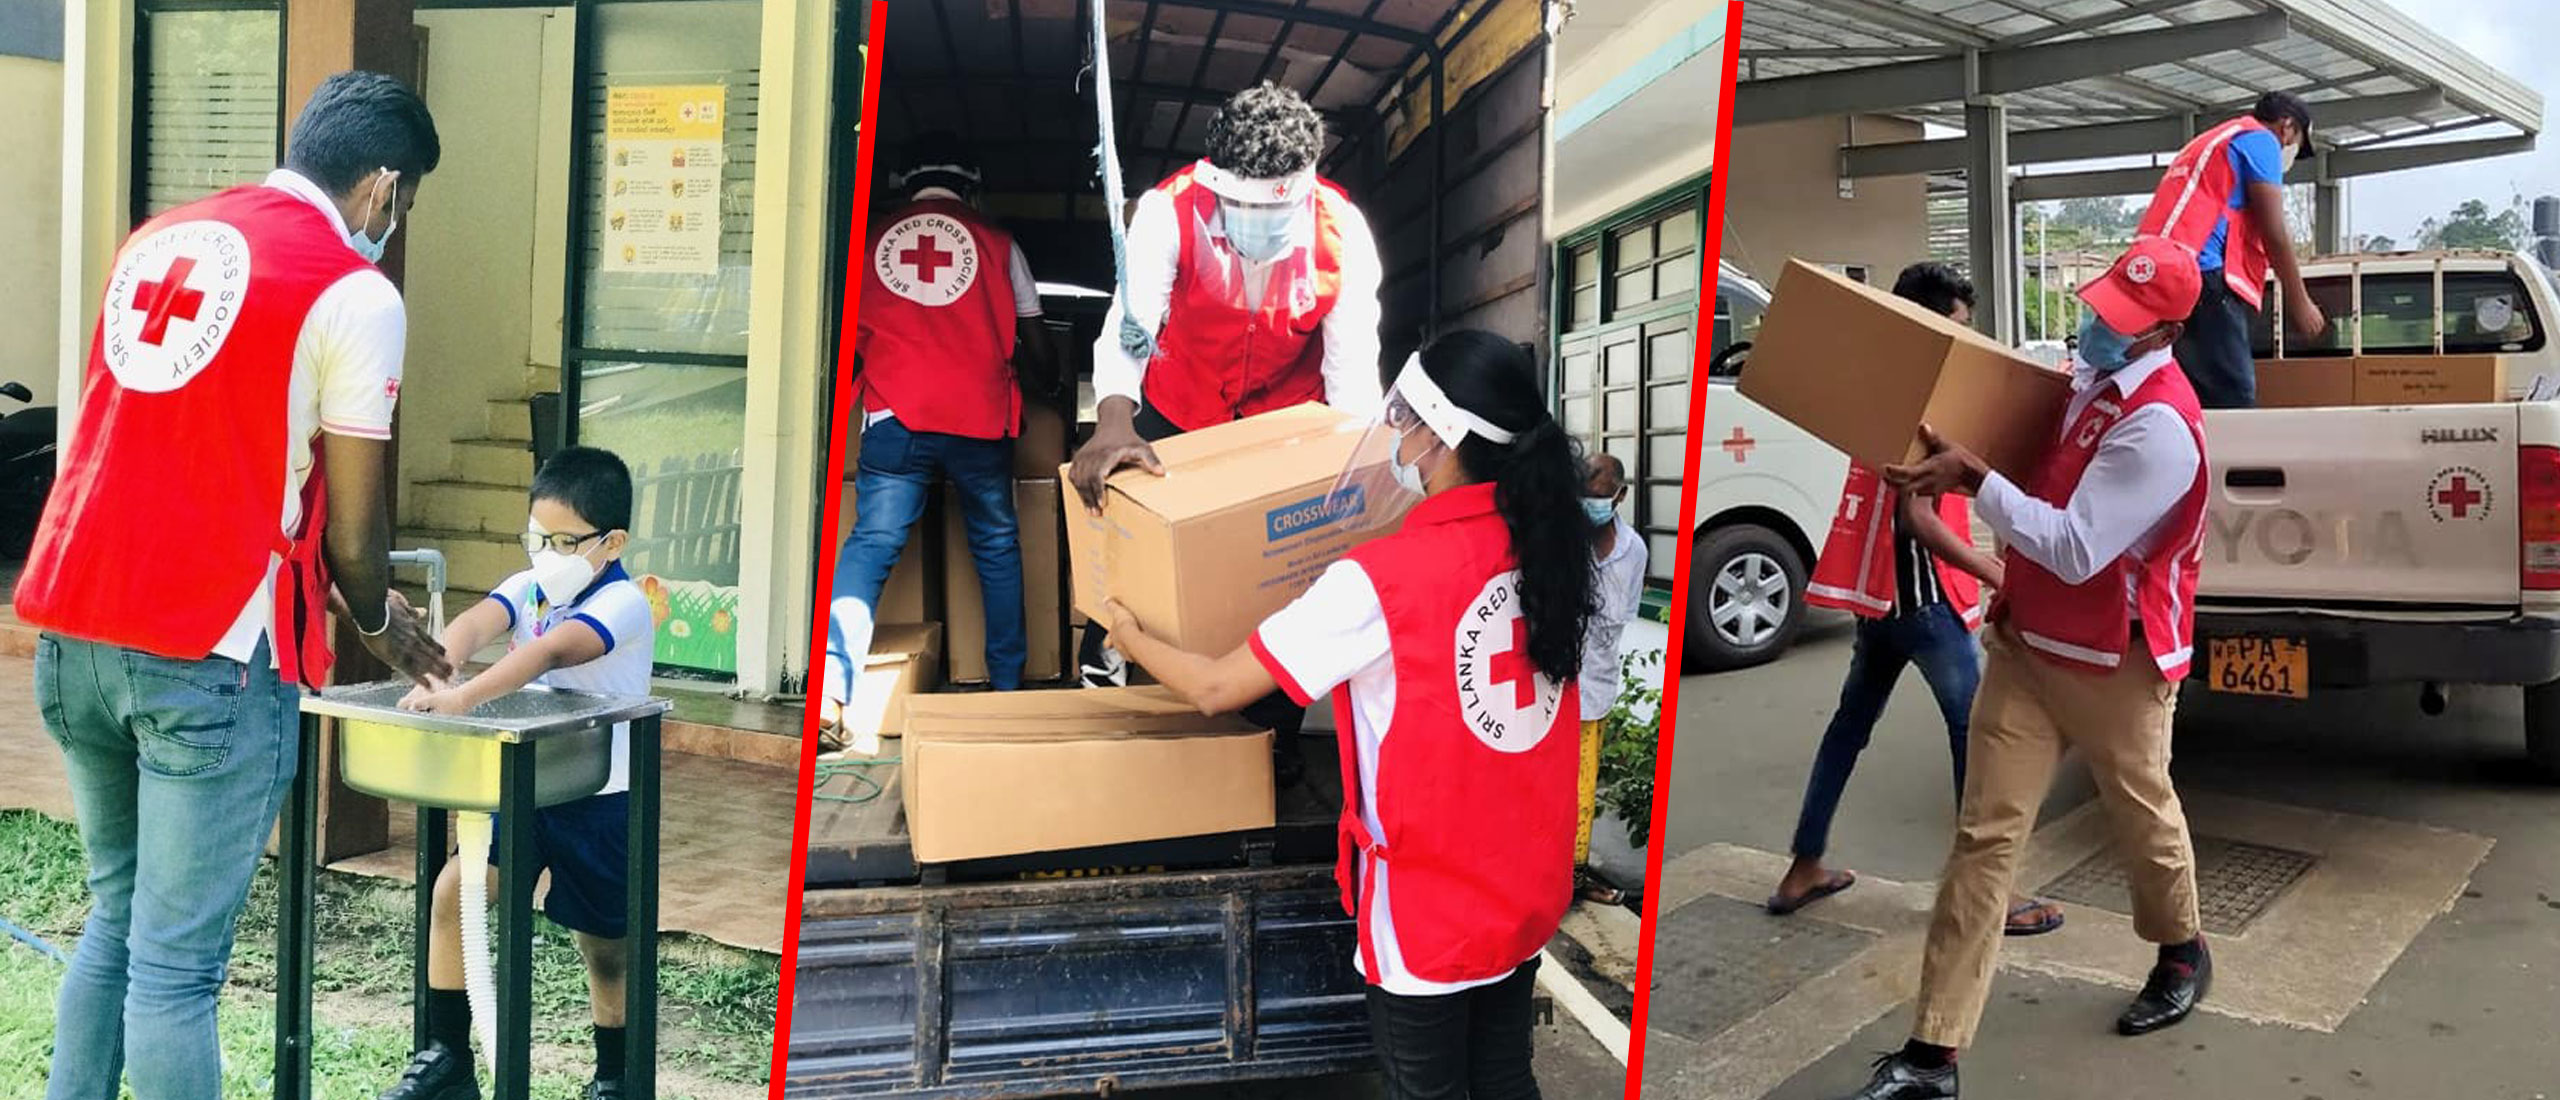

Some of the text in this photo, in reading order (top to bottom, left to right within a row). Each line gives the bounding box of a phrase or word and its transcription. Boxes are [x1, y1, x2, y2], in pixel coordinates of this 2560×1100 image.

[881, 219, 974, 298] SRI LANKA RED CROSS SOCIETY
[172, 290, 235, 379] SOCIETY
[1272, 492, 1359, 532] CROSSWEAR
[2210, 508, 2425, 569] YOTA
[1459, 586, 1508, 739] SRI LANKA RED
[2222, 662, 2295, 695] 6461
